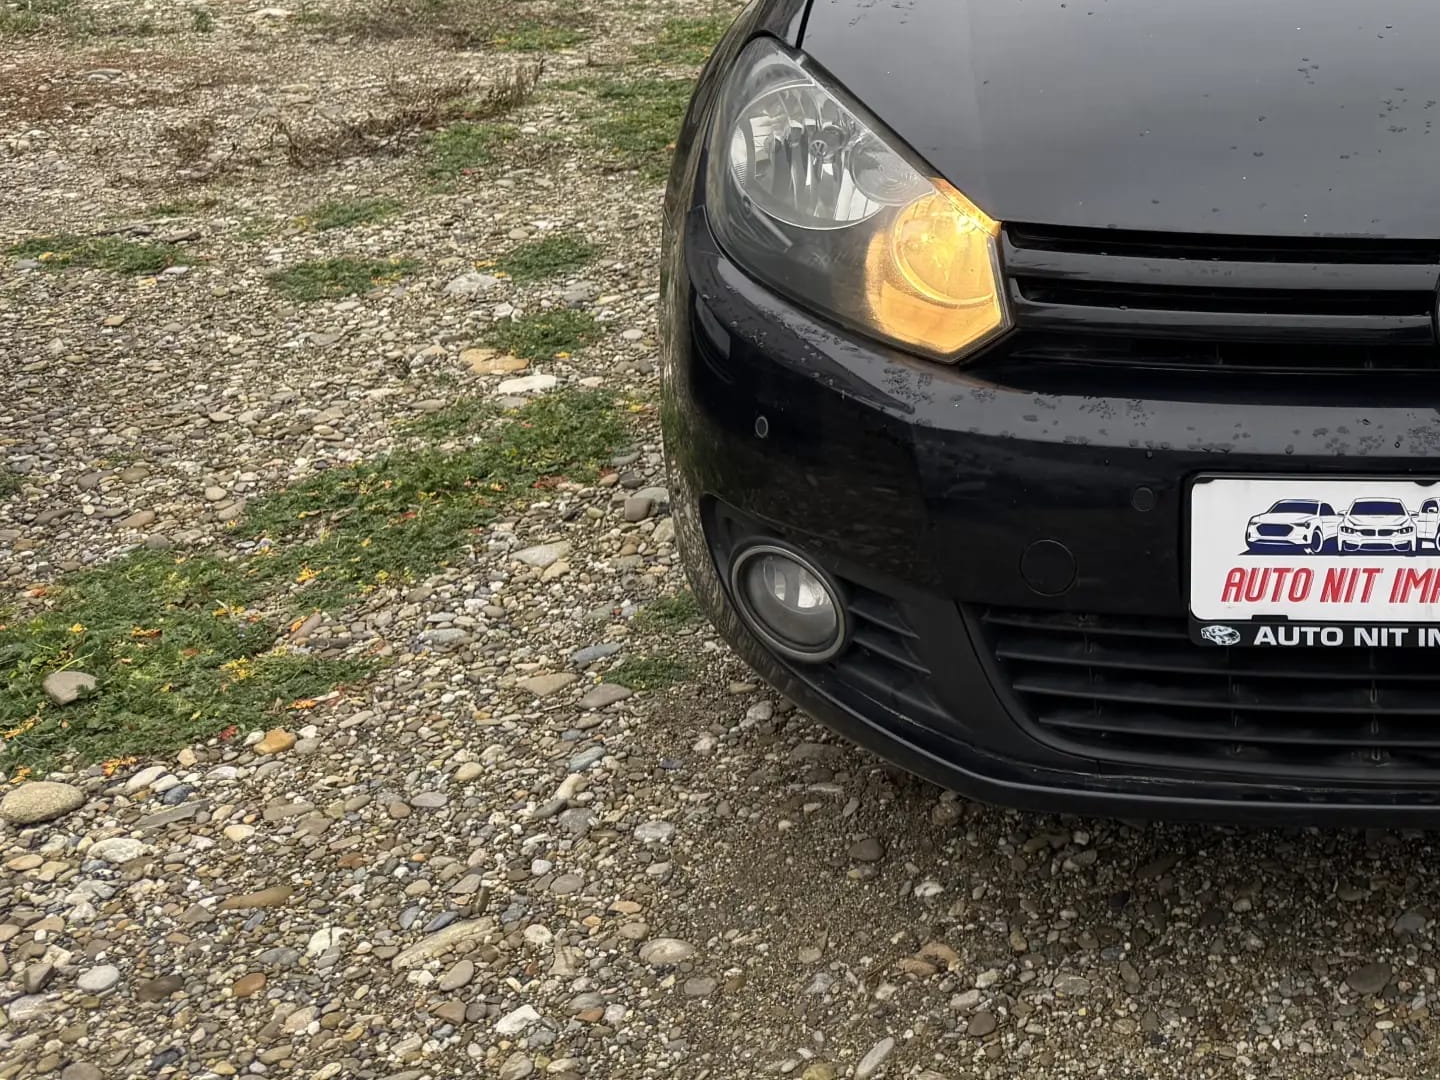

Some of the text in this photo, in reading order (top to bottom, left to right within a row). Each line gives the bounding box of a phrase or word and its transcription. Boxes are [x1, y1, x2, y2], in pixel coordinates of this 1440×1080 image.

[1220, 567, 1315, 602] AUTO
[1320, 567, 1383, 603] NIT
[1253, 626, 1343, 647] AUTO
[1354, 626, 1411, 647] NIT
